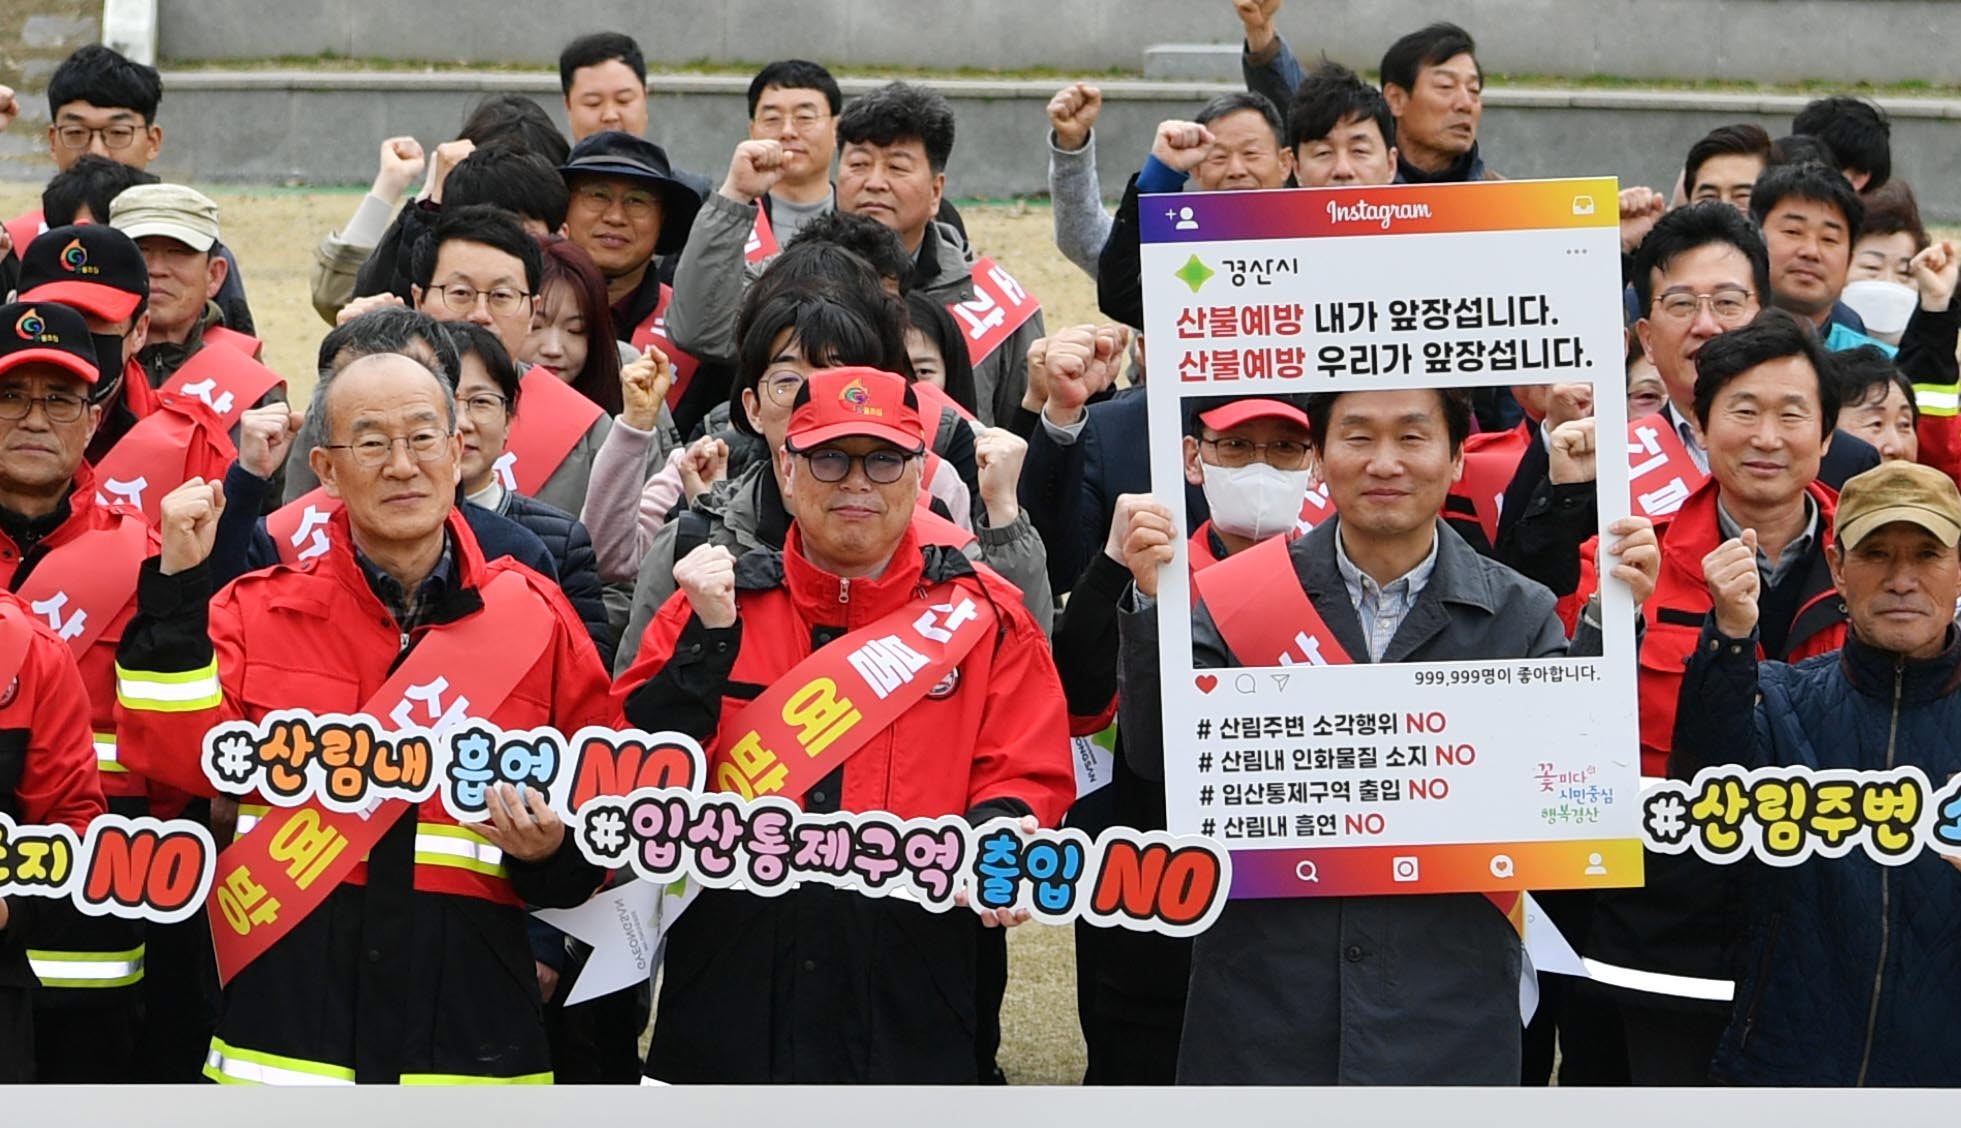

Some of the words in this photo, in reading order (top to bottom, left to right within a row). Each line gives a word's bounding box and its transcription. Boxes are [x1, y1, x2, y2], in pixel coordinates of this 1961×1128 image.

[1326, 199, 1432, 229] Instagram
[1222, 258, 1298, 287] 경산시
[1176, 303, 1304, 339] 산불예방
[1315, 301, 1378, 333] 내가
[1389, 294, 1558, 331] 앞장섭니다.
[1178, 346, 1306, 382] 산불예방
[1317, 343, 1412, 378] 우리가
[1423, 337, 1593, 373] 앞장섭니다.
[1415, 667, 1511, 687] 999,999명이
[1516, 665, 1601, 684] 좋아합니다.
[1197, 719, 1212, 740] #
[1220, 715, 1305, 739] 산림주변
[1313, 713, 1398, 736] 소각행위
[1406, 712, 1446, 733] NO
[214, 722, 430, 799] #산림내
[571, 739, 692, 810] NO
[1198, 752, 1213, 772] #
[1221, 749, 1284, 773] 산림내
[1292, 747, 1377, 771] 인화물질
[1386, 745, 1427, 768] 소지
[1436, 744, 1476, 766] NO
[1200, 785, 1214, 806] #
[1223, 780, 1350, 806] 입산통제구역
[1359, 779, 1400, 801] 출입
[1409, 778, 1449, 800] NO
[1560, 784, 1614, 805] 시민중심
[1201, 818, 1216, 838] #
[1224, 815, 1288, 839] 산림내
[1295, 814, 1337, 836] 흡연
[1345, 813, 1385, 835] NO
[1541, 804, 1600, 825] 행복경산
[1645, 777, 1920, 854] #산림주변
[0, 828, 69, 884] 지
[85, 828, 205, 910] NO
[588, 800, 962, 899] #입산통제구역
[976, 831, 1081, 912] 출입
[1092, 840, 1218, 924] NO
